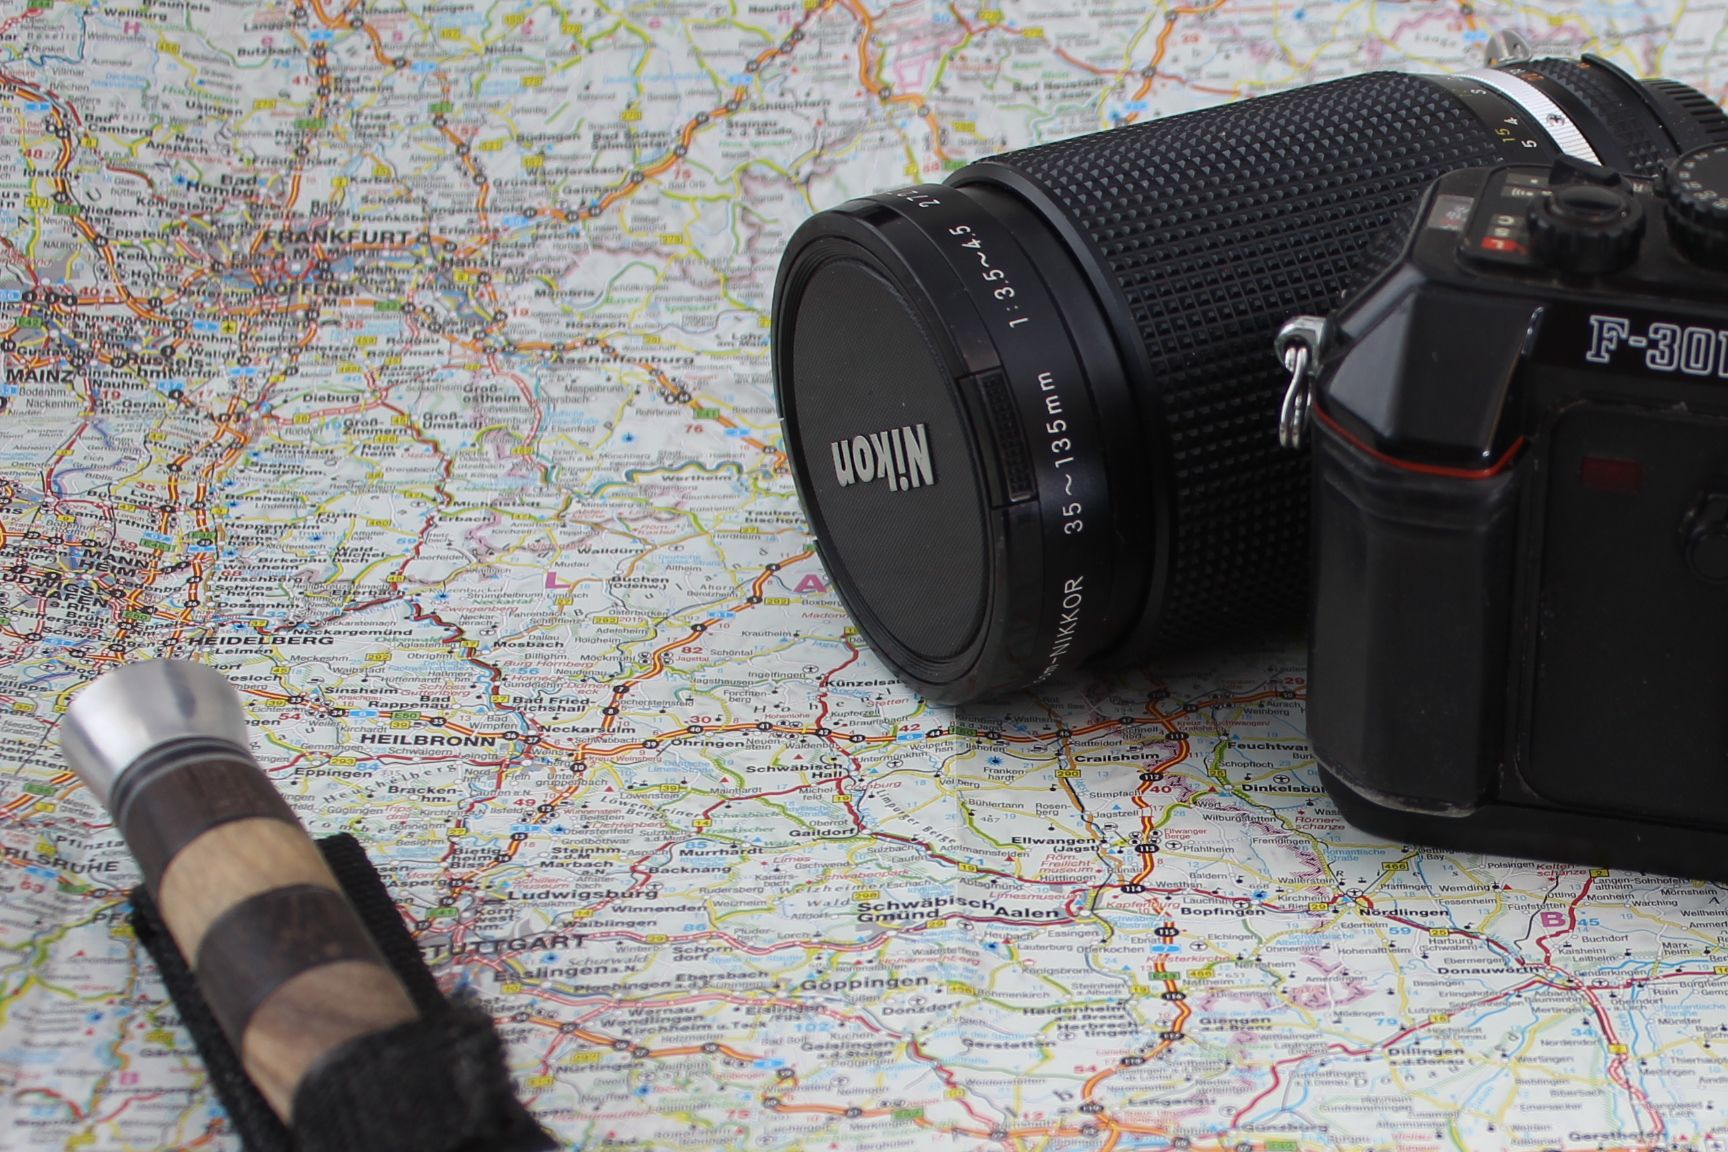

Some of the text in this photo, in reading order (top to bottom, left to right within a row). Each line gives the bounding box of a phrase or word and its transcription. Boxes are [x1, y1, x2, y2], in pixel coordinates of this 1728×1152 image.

[264, 230, 411, 245] FRANKFURT
[949, 225, 1029, 328] 1:3.5~4.5
[274, 283, 361, 297] OFFENB.
[6, 368, 74, 384] MAINZ
[831, 423, 935, 492] Nikon
[1038, 371, 1083, 534] 35~135mm
[189, 636, 334, 647] HEIDELBERG
[361, 734, 497, 748] HEILBRONN
[1228, 742, 1309, 751] Feuchtwa
[746, 763, 843, 774] Schwäbisch
[508, 889, 658, 901] Ludwigsburg
[857, 897, 996, 912] Schwäbisch
[858, 908, 941, 922] Gmünd
[995, 906, 1060, 919] Aalen
[424, 932, 593, 957] TUTTGART
